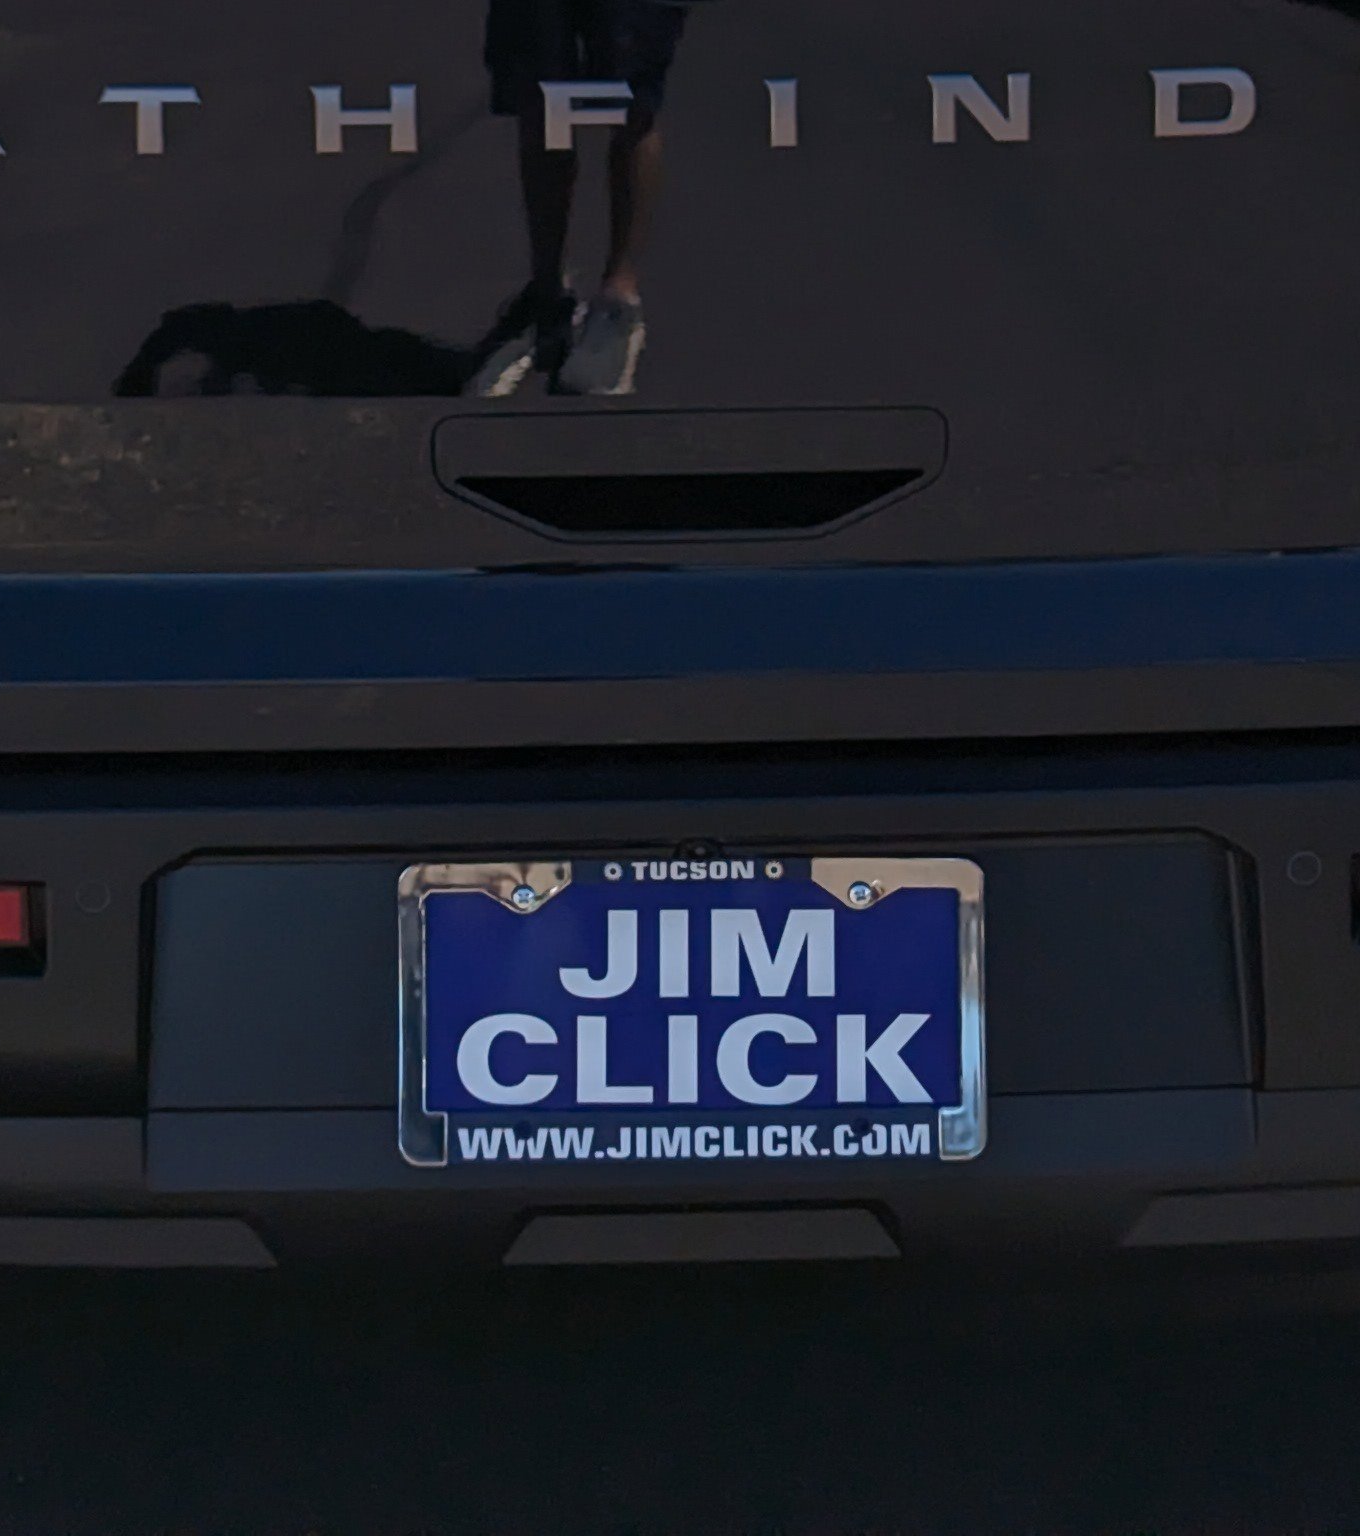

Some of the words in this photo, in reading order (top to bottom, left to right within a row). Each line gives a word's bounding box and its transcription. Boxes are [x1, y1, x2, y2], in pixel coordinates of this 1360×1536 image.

[632, 860, 755, 881] TUCSON
[559, 909, 836, 999] JIM
[457, 1013, 934, 1105] CLICK
[458, 1124, 930, 1159] WWW.JIMCLICK.COM
